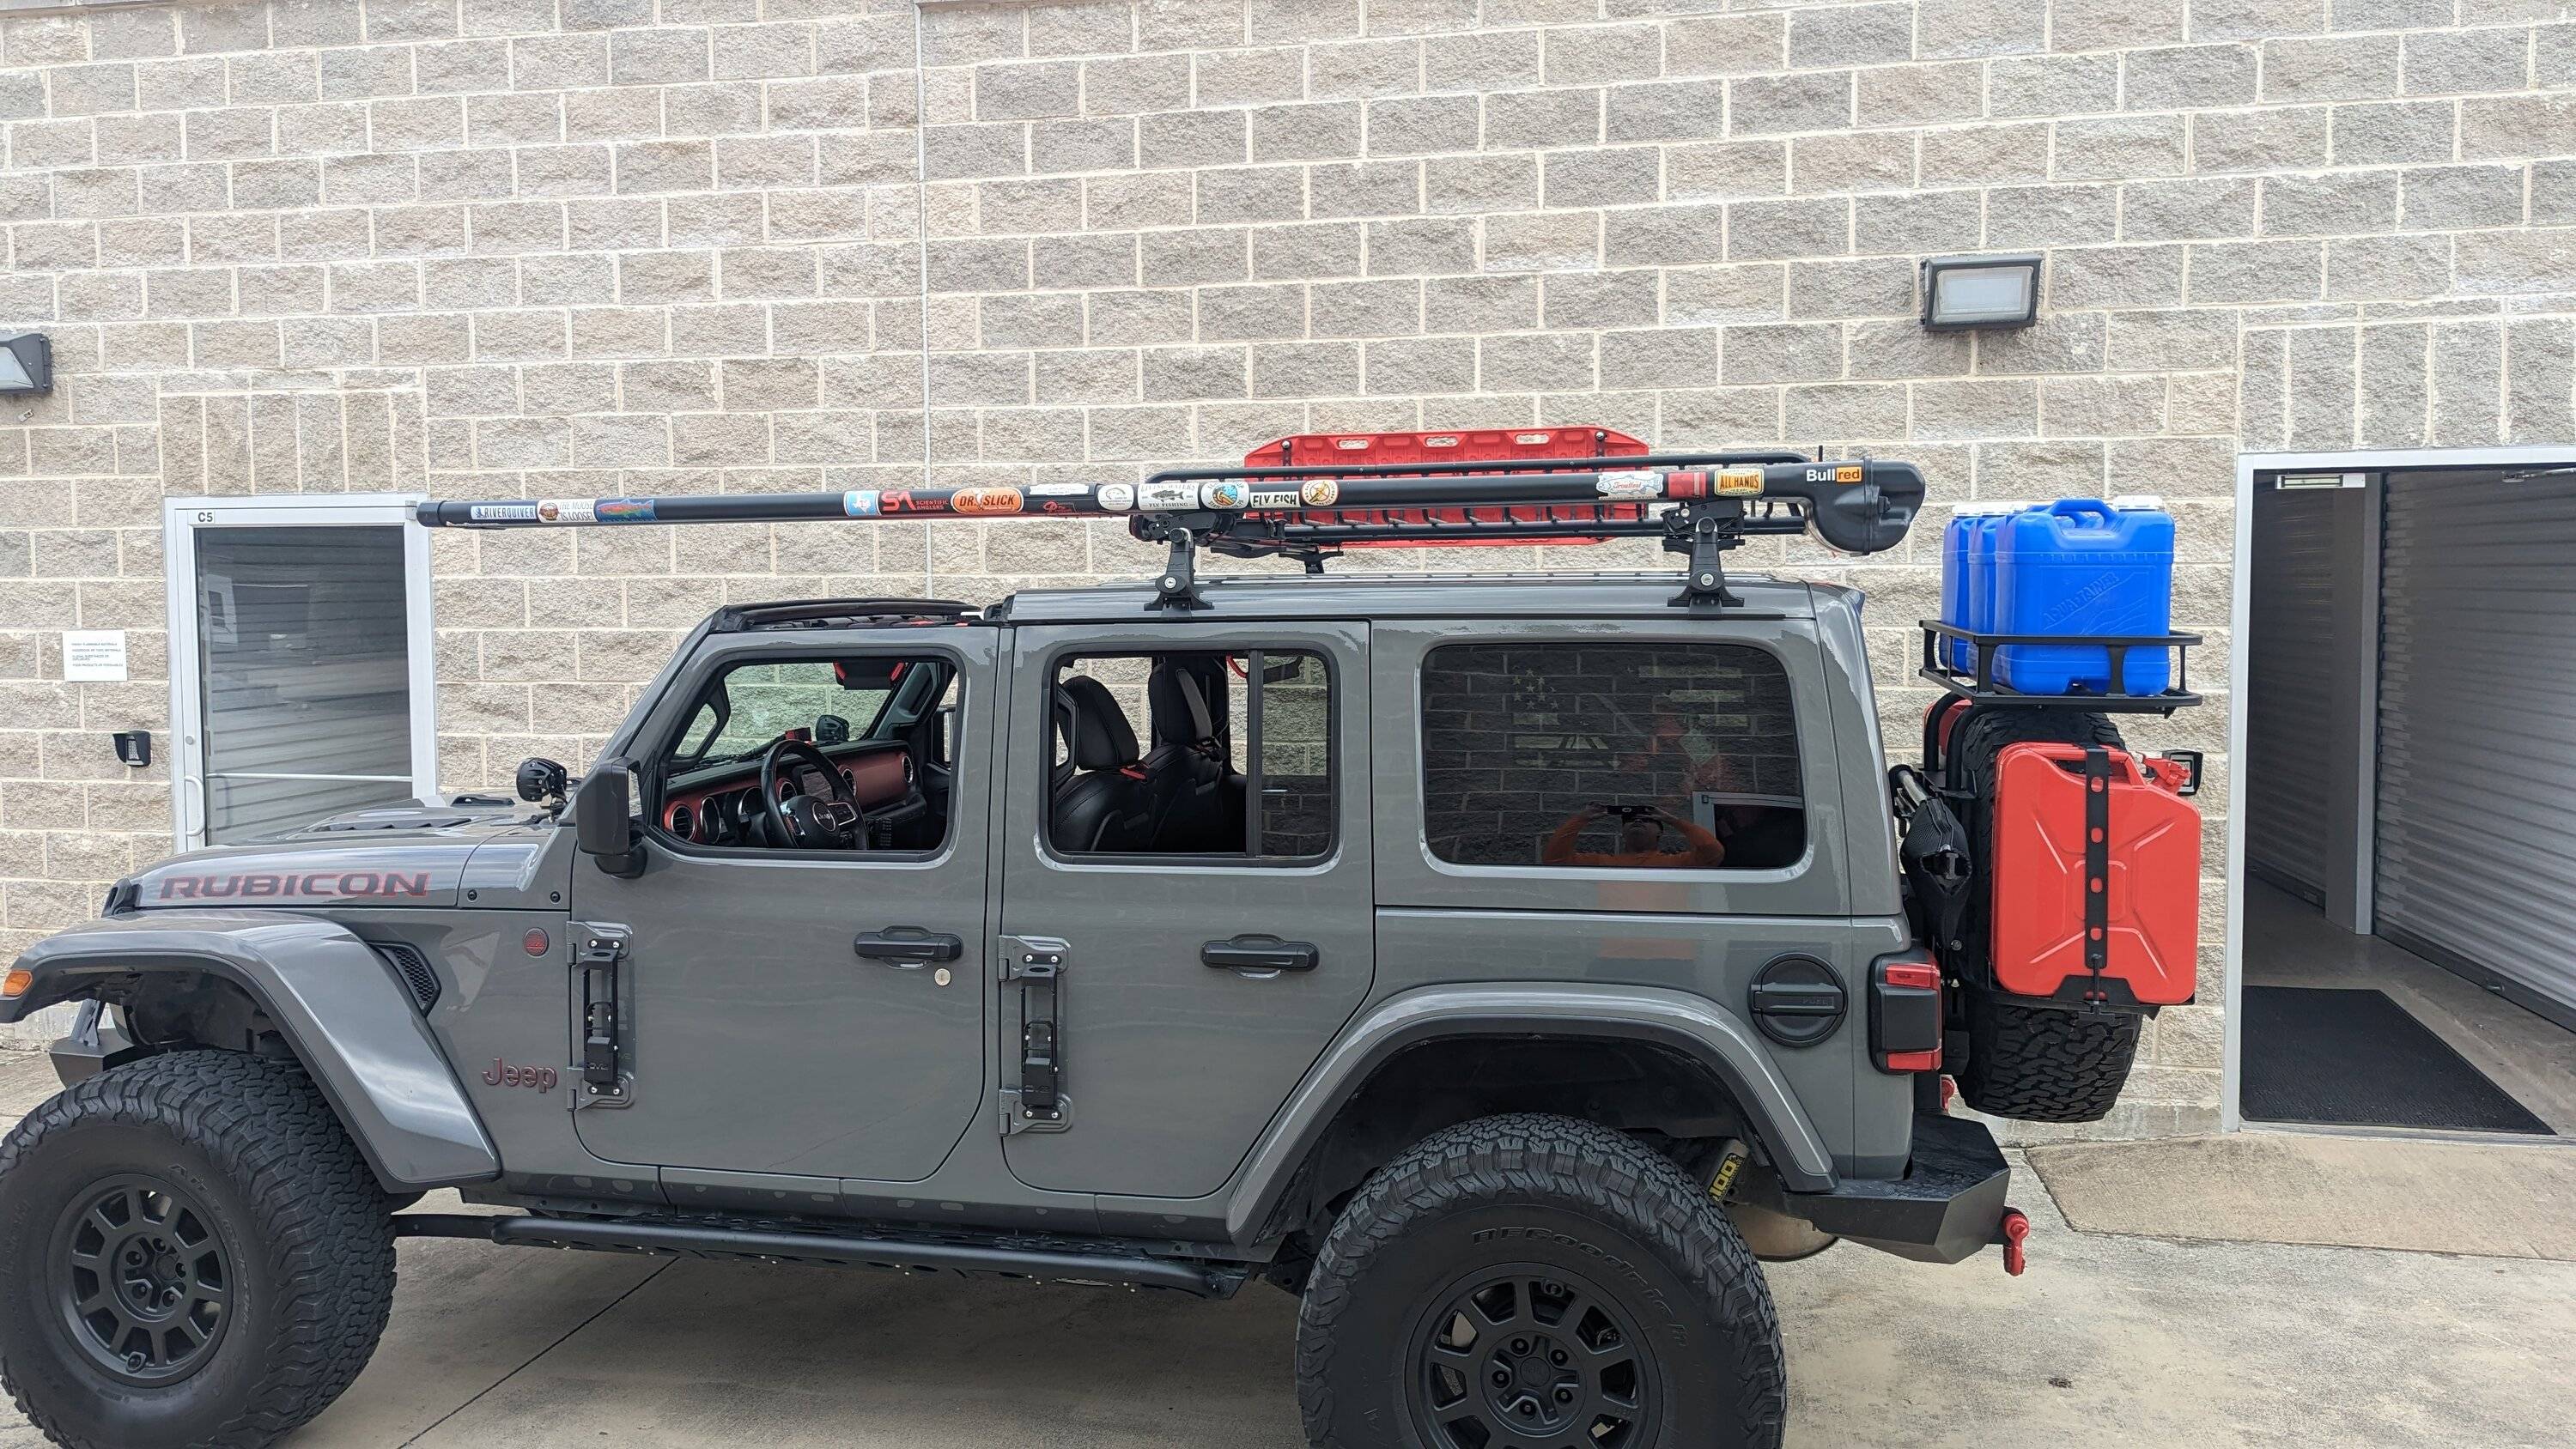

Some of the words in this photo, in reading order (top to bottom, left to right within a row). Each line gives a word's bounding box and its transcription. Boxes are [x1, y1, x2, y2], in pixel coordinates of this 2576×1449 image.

[1806, 469, 1836, 482] Bull
[1838, 469, 1860, 480] red
[1720, 475, 1732, 489] ALL
[1734, 475, 1759, 488] HANDS
[572, 500, 593, 510] MOOSE
[959, 495, 976, 506] DR.
[983, 494, 1016, 506] SLICK
[1254, 494, 1270, 506] FLY
[1273, 494, 1297, 506] FISH
[197, 512, 214, 523] C5
[483, 507, 535, 517] RIVERQUIVER
[160, 872, 430, 899] RUBICON
[482, 1058, 557, 1094] Jeep
